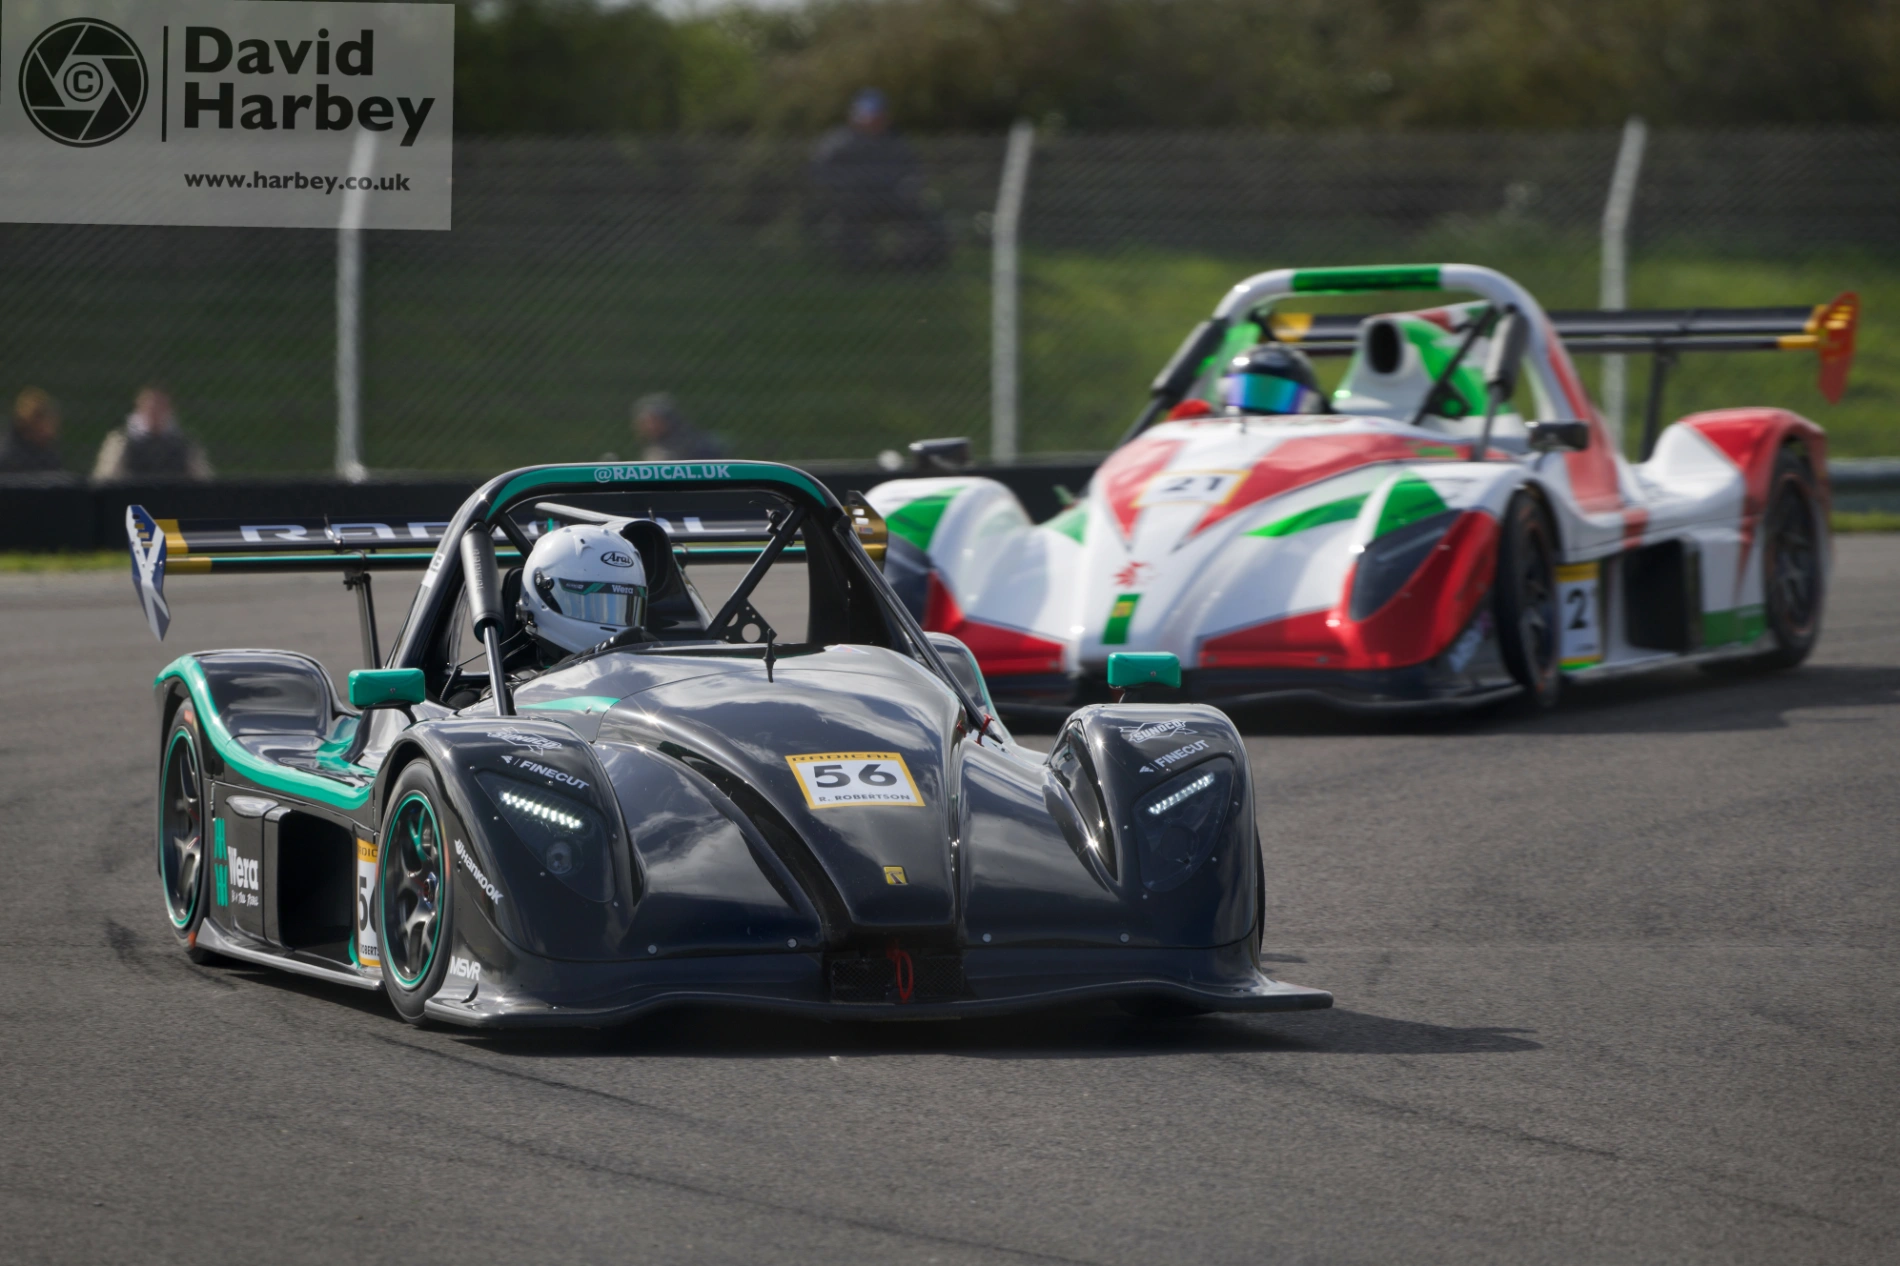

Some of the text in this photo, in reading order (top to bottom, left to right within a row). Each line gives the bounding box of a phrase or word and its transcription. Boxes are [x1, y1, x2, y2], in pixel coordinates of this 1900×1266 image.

[594, 465, 731, 483] @RADICAL.UK
[1162, 476, 1224, 492] 21
[604, 552, 631, 565] Arai
[612, 584, 634, 595] Wera
[1132, 719, 1183, 742] SUNOCO
[1154, 739, 1210, 768] FINECUT
[519, 760, 590, 790] FINECUT
[813, 763, 898, 788] 56
[227, 845, 259, 890] Wera
[450, 955, 481, 981] MSVR
